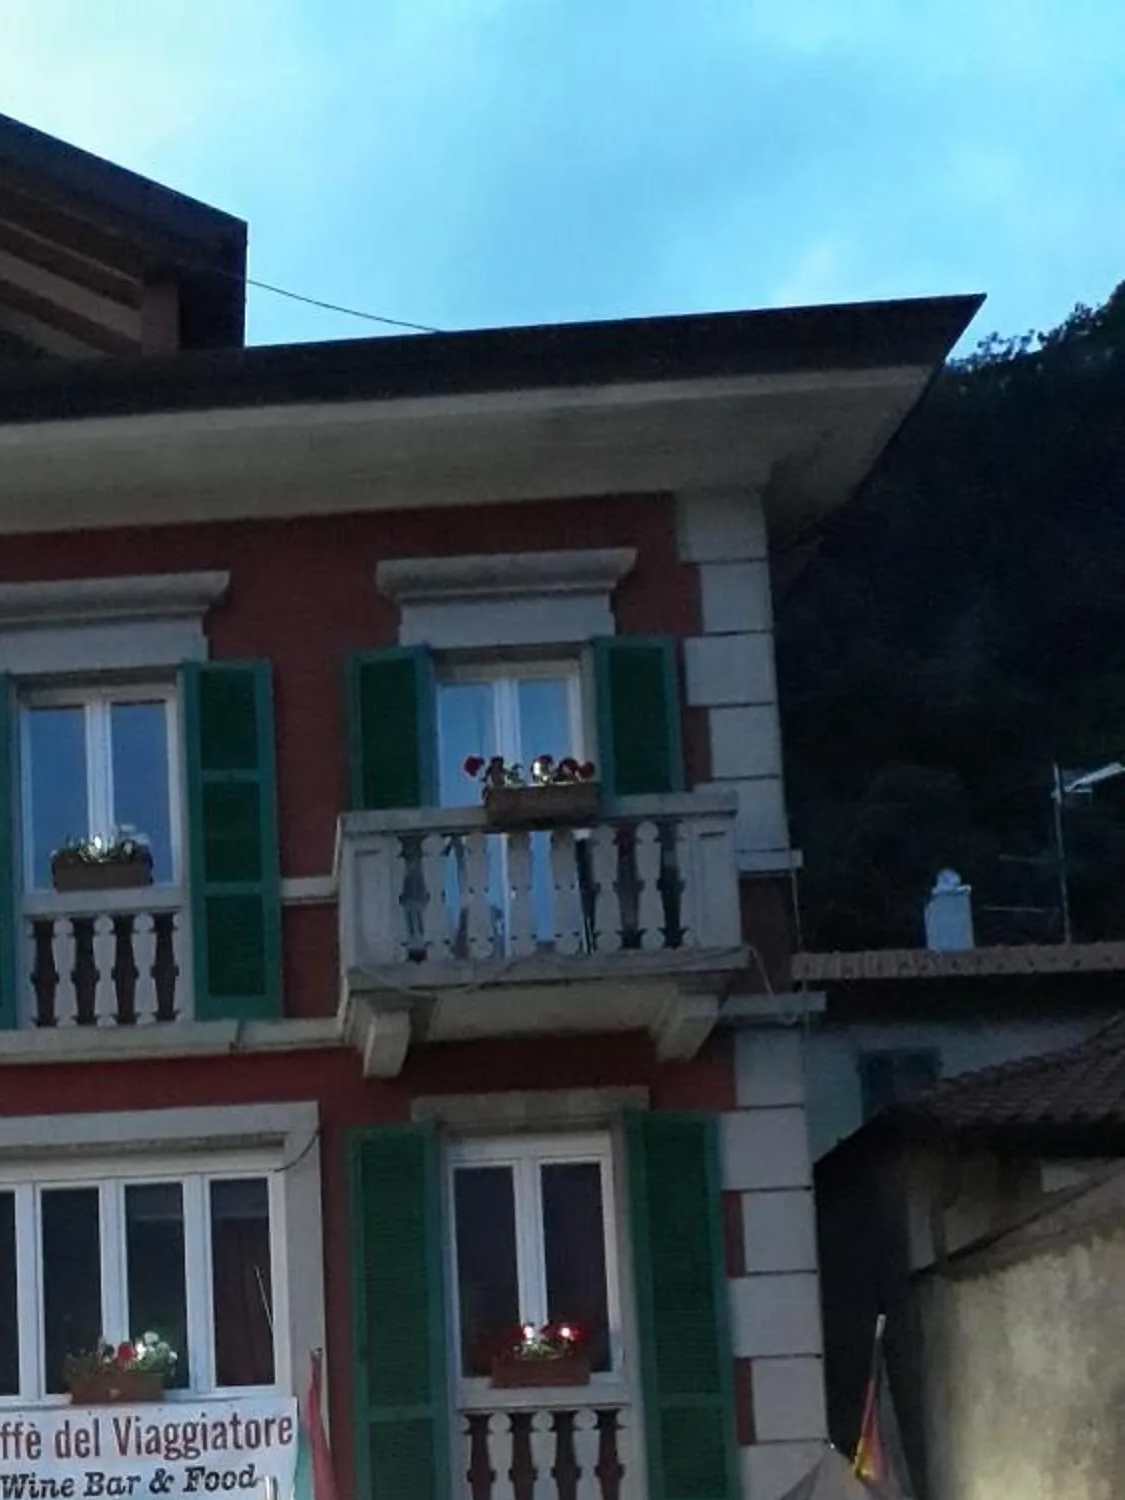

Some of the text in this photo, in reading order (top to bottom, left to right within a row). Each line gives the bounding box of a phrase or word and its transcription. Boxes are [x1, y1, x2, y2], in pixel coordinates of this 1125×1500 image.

[54, 1417, 101, 1459] del
[112, 1411, 293, 1461] Viaggiatore
[0, 1463, 257, 1500] Wine Bar & Food
